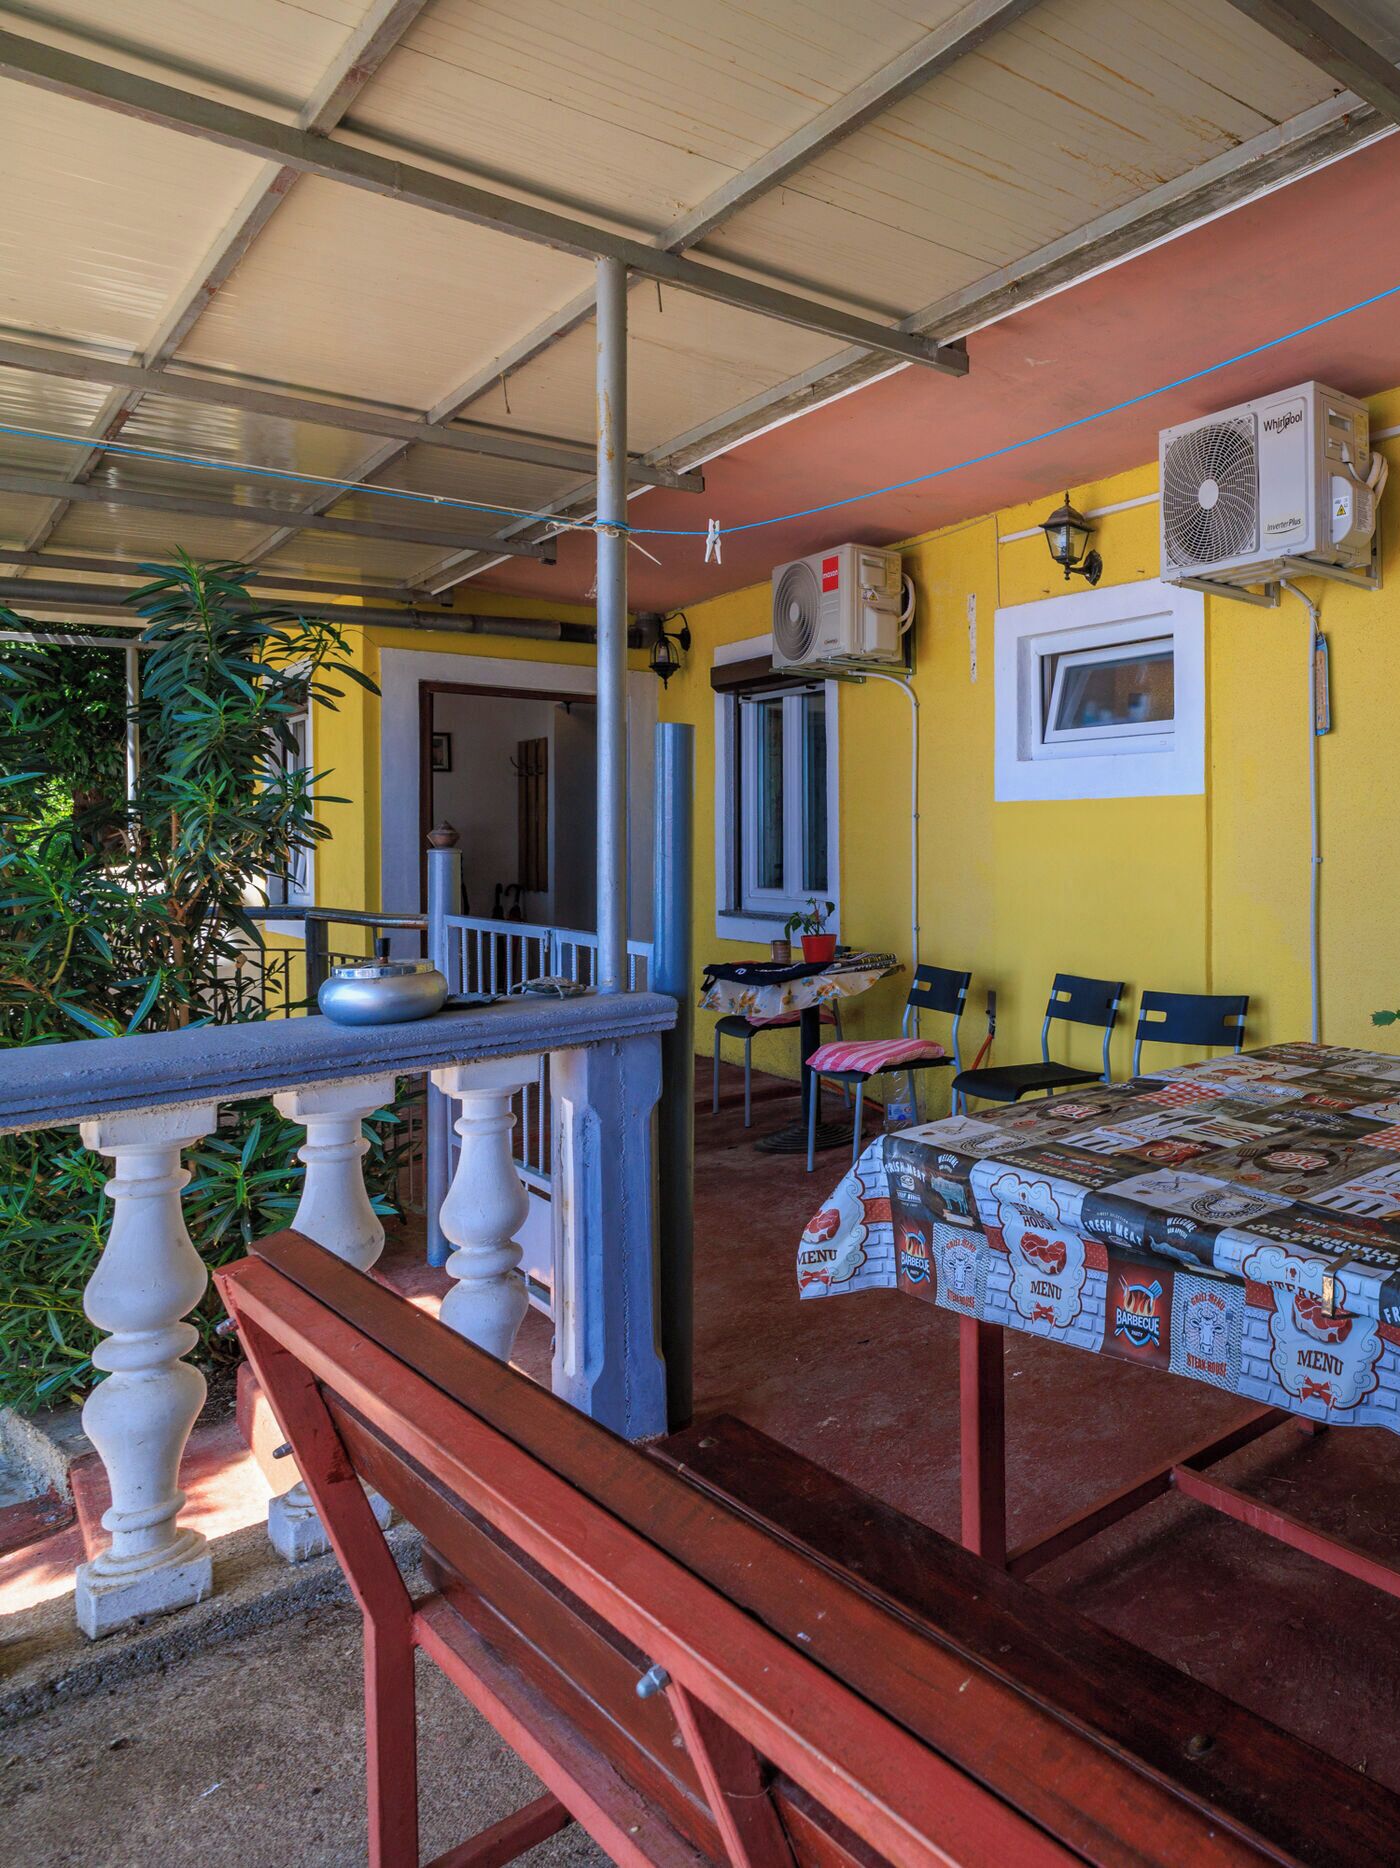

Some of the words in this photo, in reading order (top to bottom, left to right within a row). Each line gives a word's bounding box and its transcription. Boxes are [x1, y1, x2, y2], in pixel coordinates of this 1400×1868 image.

[1263, 410, 1302, 433] Whirlpool
[1023, 1216, 1058, 1231] HOUSE
[1084, 1220, 1112, 1235] FRESH
[1115, 1222, 1142, 1246] MEAT
[1166, 1217, 1198, 1233] WELCOME
[901, 1251, 931, 1272] BARBECUE
[1030, 1281, 1062, 1300] MENU
[1116, 1308, 1161, 1336] BARBECUE
[1186, 1353, 1206, 1370] STEAK
[1206, 1358, 1227, 1377] HOUSE
[1297, 1350, 1345, 1377] MENU
